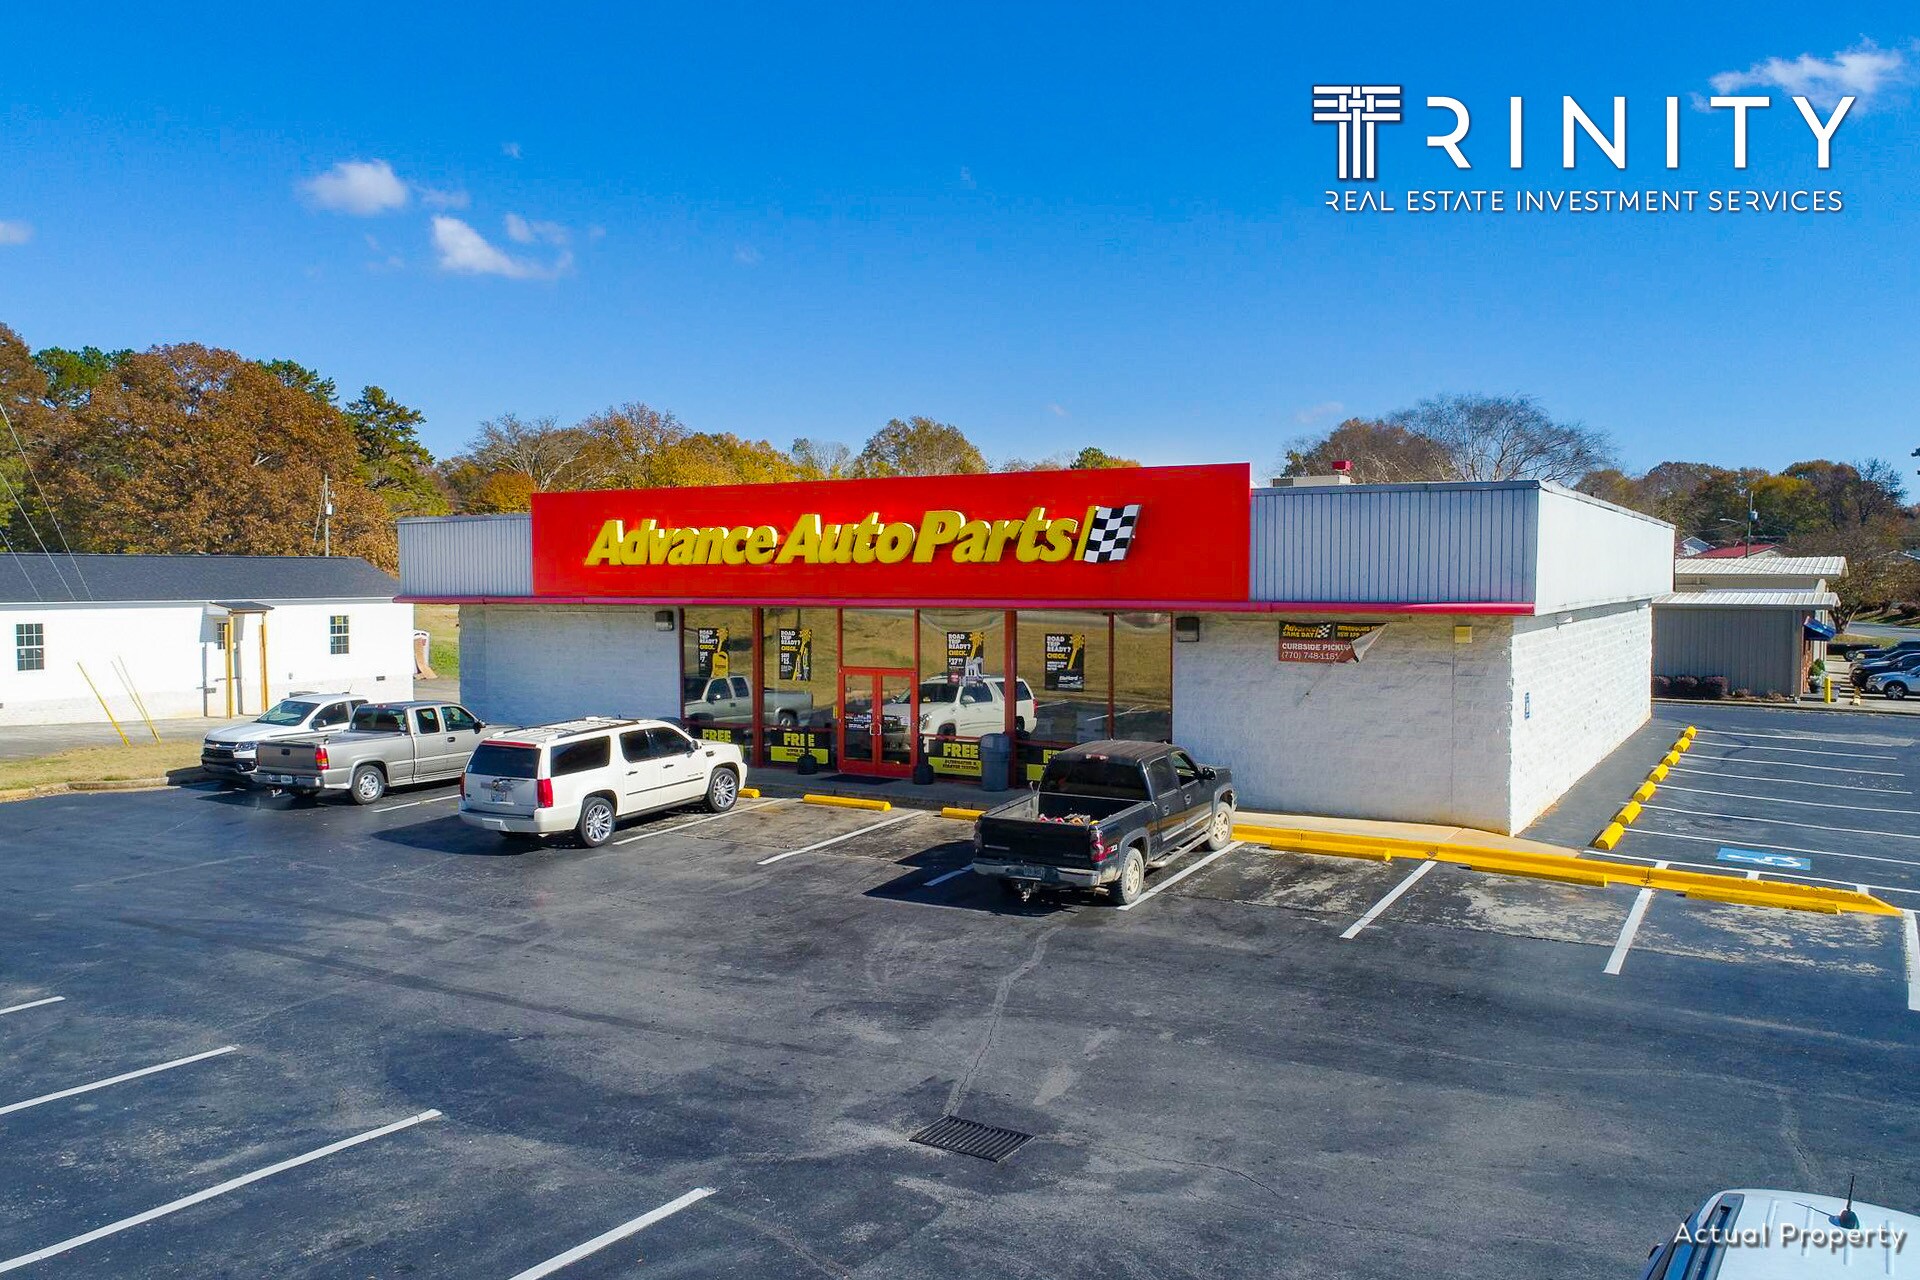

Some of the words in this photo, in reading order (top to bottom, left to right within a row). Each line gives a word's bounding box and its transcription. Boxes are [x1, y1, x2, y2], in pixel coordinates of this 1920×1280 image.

[1282, 643, 1321, 651] CURBSIDE
[1281, 651, 1301, 659] (770)
[702, 728, 731, 742] FREE
[943, 743, 979, 758] FREE
